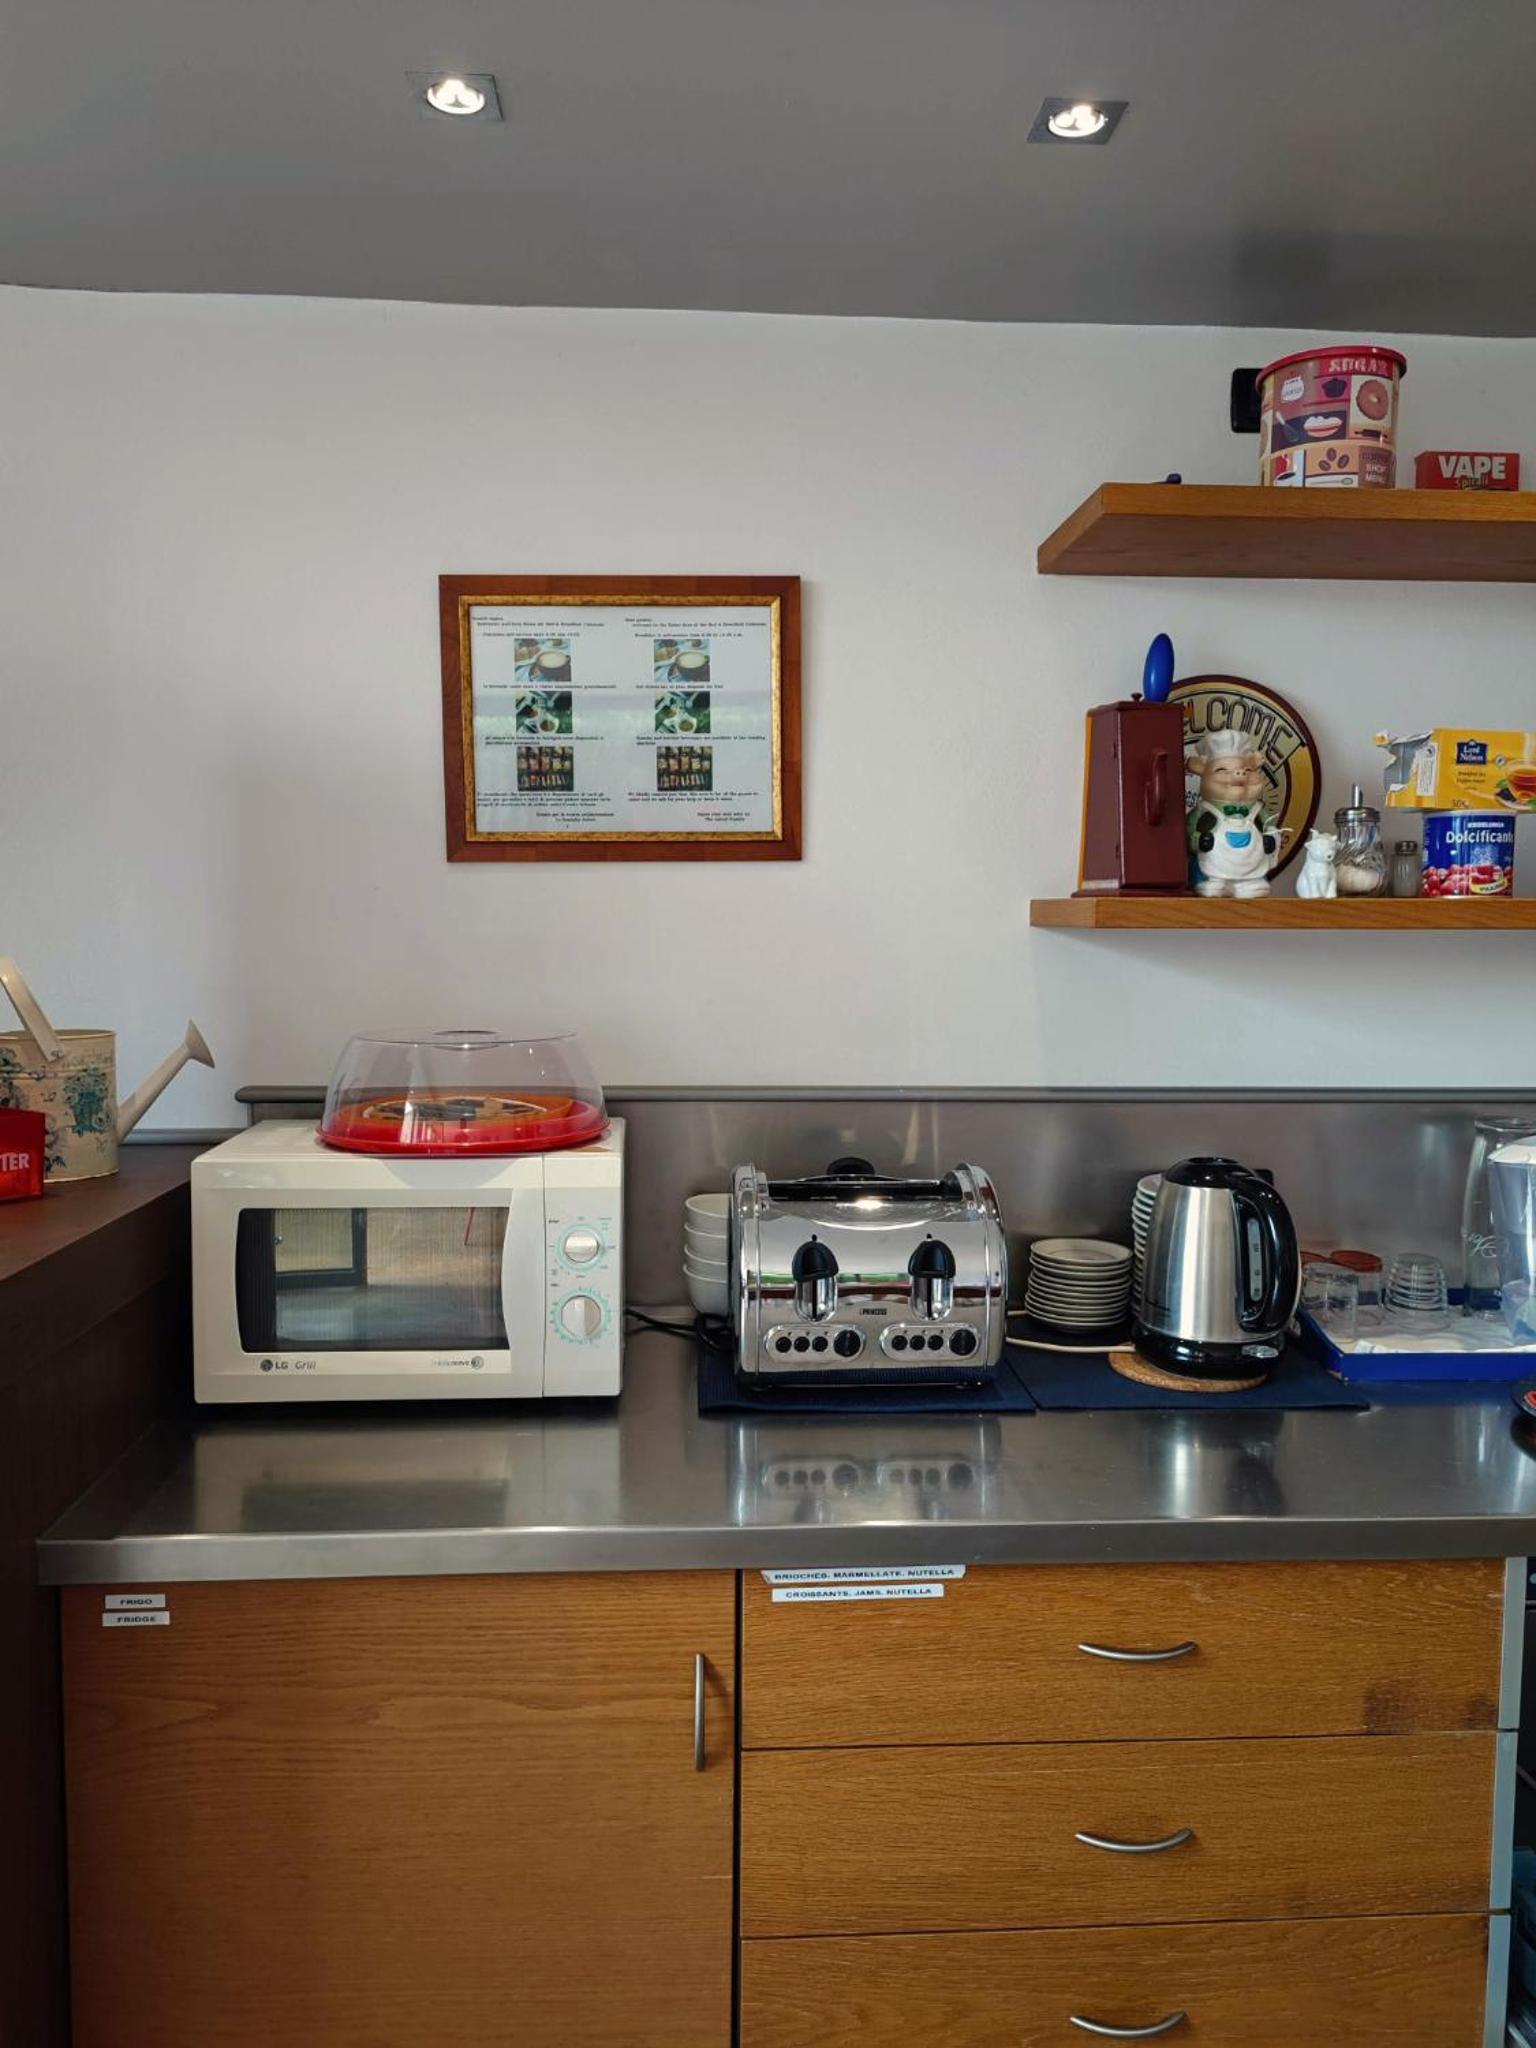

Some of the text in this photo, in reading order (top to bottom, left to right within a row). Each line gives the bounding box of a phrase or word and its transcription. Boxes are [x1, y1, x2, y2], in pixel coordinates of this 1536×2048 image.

[1328, 357, 1388, 376] SUGAR
[1438, 455, 1507, 480] VAPE
[275, 1360, 317, 1370] LG Grill
